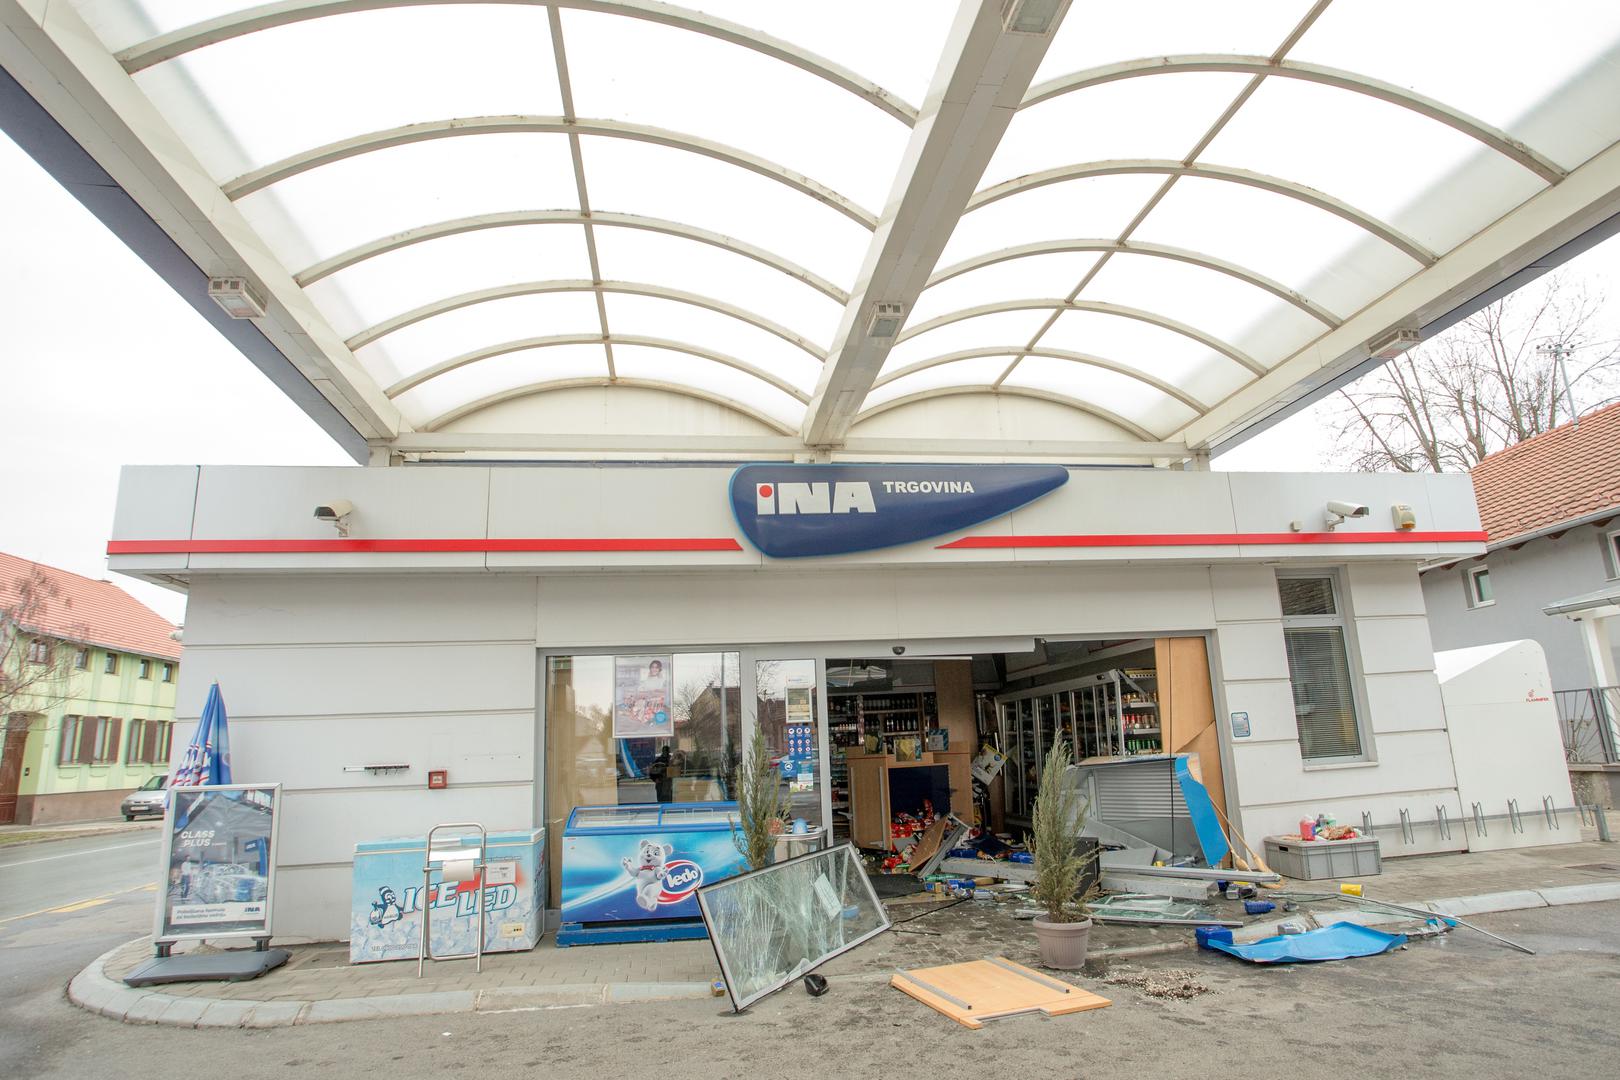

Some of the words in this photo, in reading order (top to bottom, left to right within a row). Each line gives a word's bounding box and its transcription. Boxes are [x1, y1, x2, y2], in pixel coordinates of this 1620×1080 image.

[882, 481, 975, 494] TRGOVINA
[181, 830, 214, 838] CLASS
[183, 838, 211, 847] PLUS
[668, 868, 698, 888] ledo
[403, 881, 459, 914] ICE
[456, 884, 517, 917] LED
